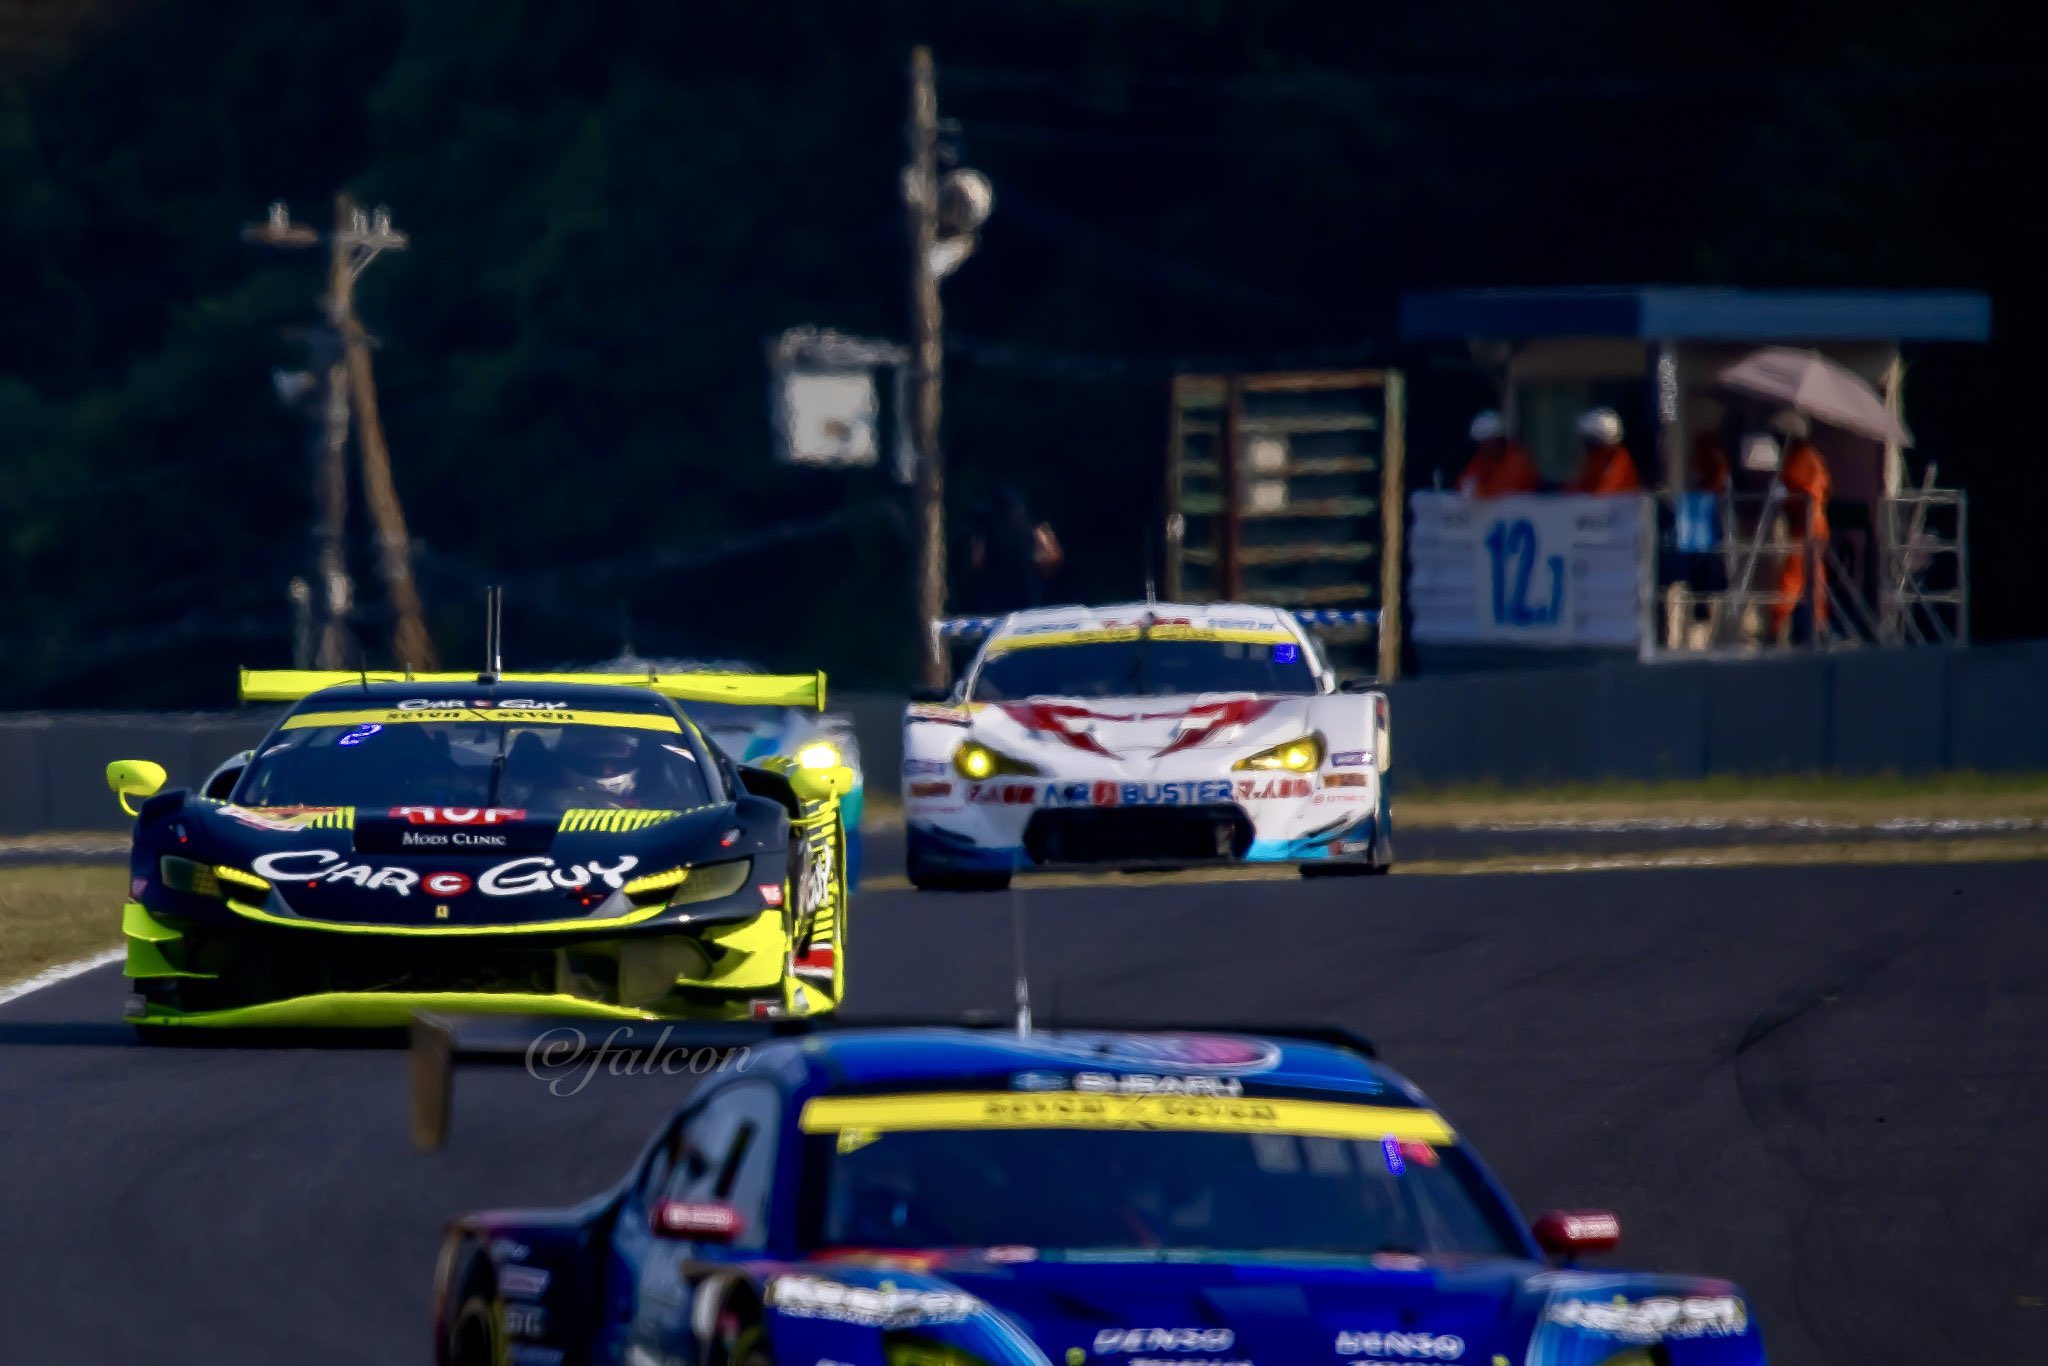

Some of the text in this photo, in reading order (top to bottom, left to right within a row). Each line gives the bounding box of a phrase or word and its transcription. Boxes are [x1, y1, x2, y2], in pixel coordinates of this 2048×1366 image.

[339, 723, 383, 746] 2
[1122, 780, 1233, 804] BUSTER
[1094, 1328, 1235, 1353] DENSO
[1335, 1330, 1464, 1359] DENSO
